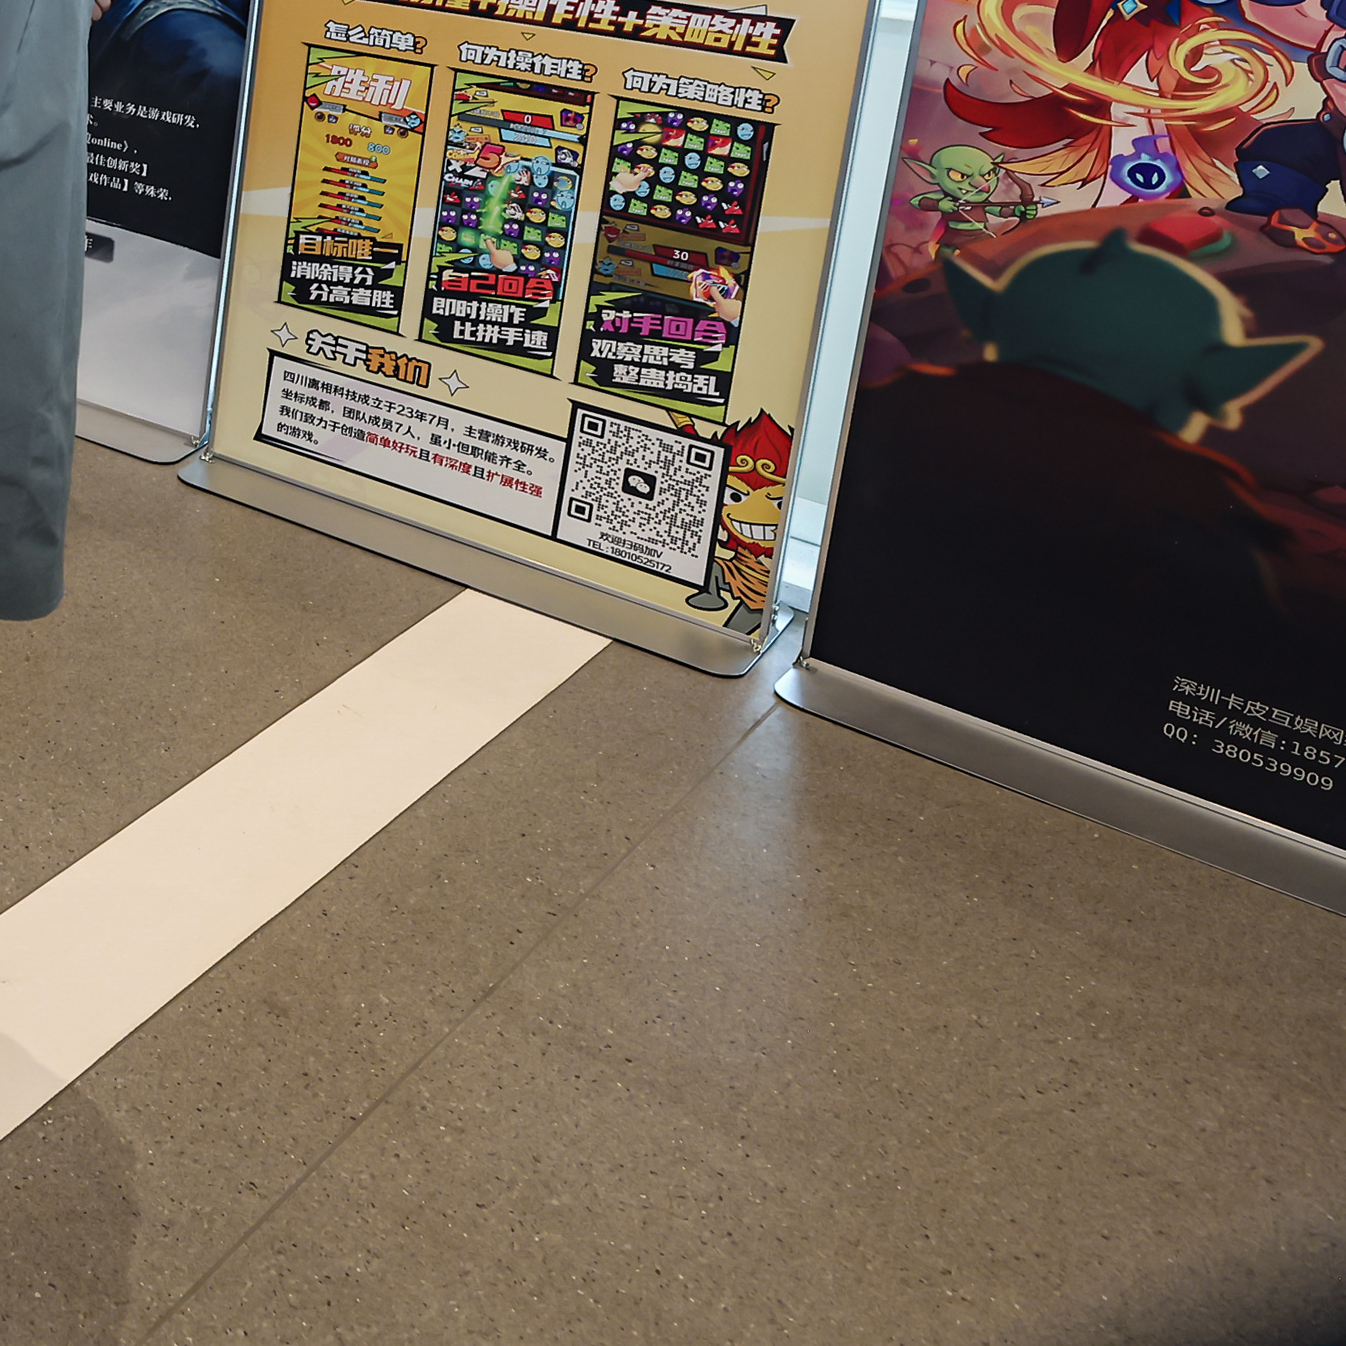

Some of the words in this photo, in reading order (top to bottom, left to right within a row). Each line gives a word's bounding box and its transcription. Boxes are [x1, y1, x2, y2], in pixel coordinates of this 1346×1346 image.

[324, 65, 411, 110] 胜利
[368, 143, 390, 154] 800
[476, 142, 505, 169] 5
[299, 234, 398, 259] 目标唯一
[673, 250, 689, 261] 30
[290, 261, 374, 285] 消除得分
[442, 269, 554, 300] 自己回合
[310, 283, 394, 308] 分高者胜
[432, 297, 526, 324] 即时操作
[453, 321, 548, 349] 比拼手速
[601, 310, 727, 344] 对手回合
[307, 330, 430, 387] 关于我们
[590, 339, 696, 369] 观察思考
[612, 364, 720, 396] 整蛊捣乱
[277, 422, 319, 445] 的游戏。
[279, 405, 543, 498] 我们致力于创造简单好玩且有深度且扩展性强
[599, 532, 663, 559] 欢迎扫码加V
[1172, 676, 1346, 746] 深圳卡皮互娱网
